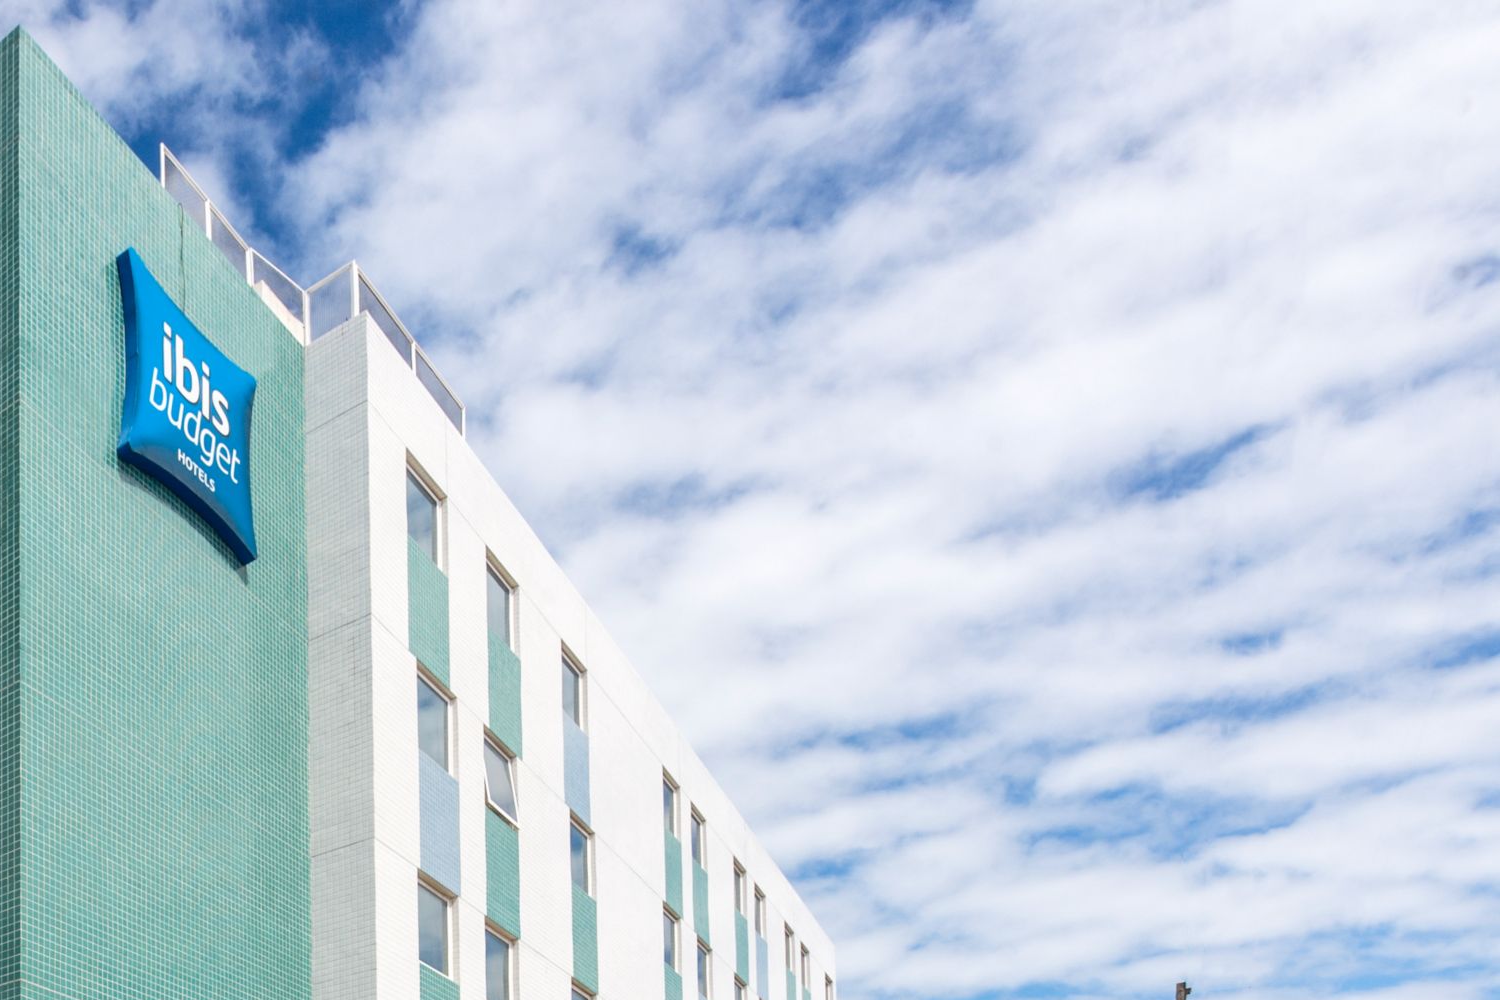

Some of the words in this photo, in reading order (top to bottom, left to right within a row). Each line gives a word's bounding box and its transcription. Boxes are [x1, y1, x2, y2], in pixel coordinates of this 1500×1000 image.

[149, 367, 241, 484] budget
[163, 321, 230, 436] ibis
[178, 448, 216, 493] HOTELS
